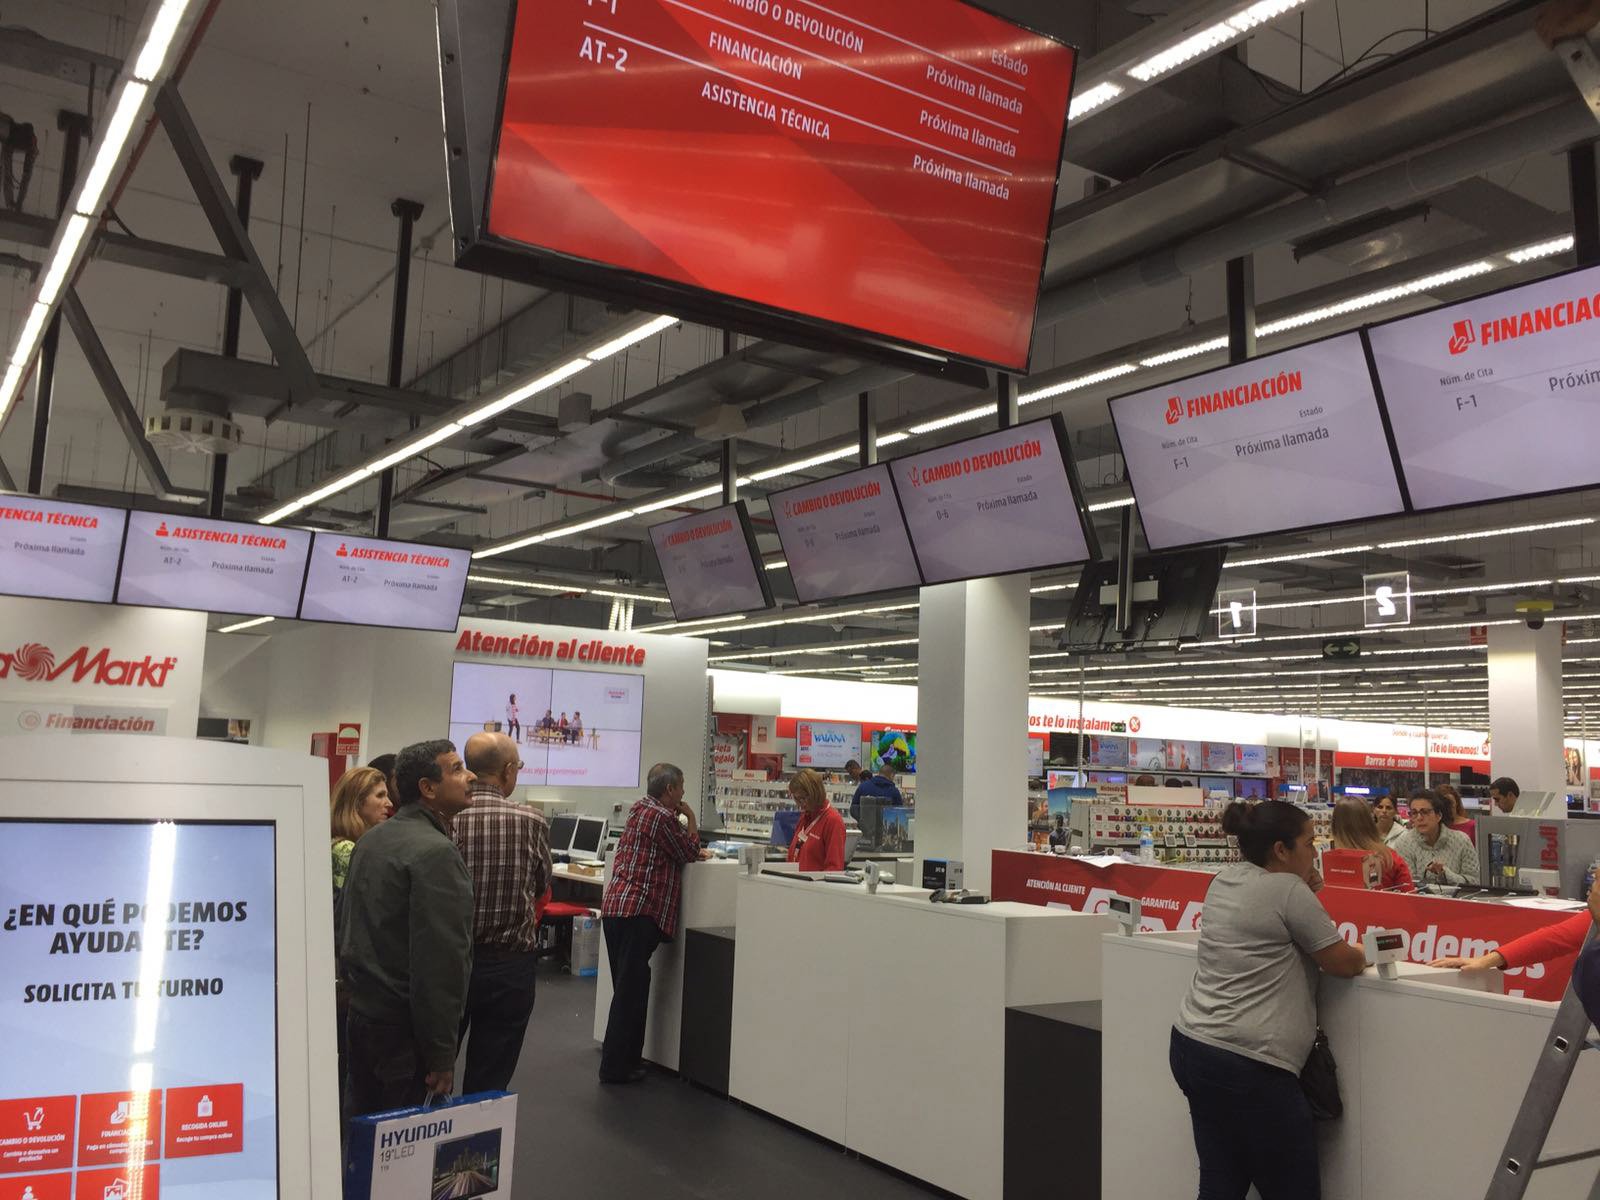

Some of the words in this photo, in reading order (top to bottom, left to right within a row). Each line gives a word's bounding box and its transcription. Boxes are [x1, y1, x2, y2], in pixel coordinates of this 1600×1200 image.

[587, 0, 617, 15] -1
[772, 4, 782, 21] O
[785, 9, 864, 53] DEVOLUCIÓN
[579, 35, 628, 72] AT-2
[709, 31, 802, 79] FINANCIACIÓN
[991, 49, 1029, 76] Estado
[926, 64, 976, 97] Próxima
[978, 83, 1023, 114] llamada
[701, 81, 776, 121] ASISTENCIA
[781, 107, 830, 139] TÉCNICA
[920, 110, 969, 141] Próxima
[971, 128, 1017, 157] llamada
[913, 154, 963, 184] Próxima
[965, 172, 1010, 200] llamada
[1465, 371, 1475, 381] de
[1477, 367, 1494, 379] Cita
[1187, 371, 1302, 418] FINANCIACIÓN
[1456, 394, 1478, 411] F-1
[1299, 406, 1323, 418] Estado
[1174, 457, 1189, 470] F-1
[1235, 438, 1281, 457] Próxima
[1282, 426, 1329, 447] llamada
[922, 461, 962, 484] CAMBIO
[963, 458, 971, 474] O
[972, 439, 1042, 472] DEVOLUCIÓN
[793, 495, 822, 515] CAMBIO
[823, 493, 829, 507] O
[830, 481, 881, 506] DEVOLUCIÓN
[977, 497, 1006, 512] Próxima
[1007, 490, 1038, 505] llamada
[47, 511, 98, 528] TÉCNICA
[14, 541, 50, 553] Próxima
[51, 545, 85, 556] llamada
[172, 527, 239, 545] ASISTENCIA
[241, 533, 287, 550] TÉCNICA
[212, 561, 243, 572] Próxima
[350, 547, 408, 563] ASISTENCIA
[411, 553, 450, 568] TÉCNICA
[456, 630, 554, 657] Atención
[556, 639, 577, 660] al
[578, 640, 646, 666] cliente
[50, 646, 178, 688] Markt
[45, 713, 155, 732] Financiación
[1028, 715, 1041, 727] os
[1043, 715, 1053, 727] te
[1055, 715, 1064, 727] lo
[1066, 715, 1124, 732] instalam
[715, 755, 735, 764] egalo
[1364, 755, 1386, 767] Barras
[1387, 756, 1395, 767] de
[1398, 757, 1418, 768] sonido
[1026, 878, 1054, 891] ATENCIÓN
[1055, 881, 1062, 892] AL
[1062, 883, 1086, 895] CLIENTE
[3, 903, 55, 931] ¿EN
[62, 898, 116, 928] QUÉ
[122, 901, 248, 925] PDEMOS
[1141, 897, 1179, 911] GARANTÍAS
[50, 929, 205, 954] AYUDATE?
[24, 982, 116, 1003] SOLICITA
[380, 1119, 453, 1148] HYUNDAI
